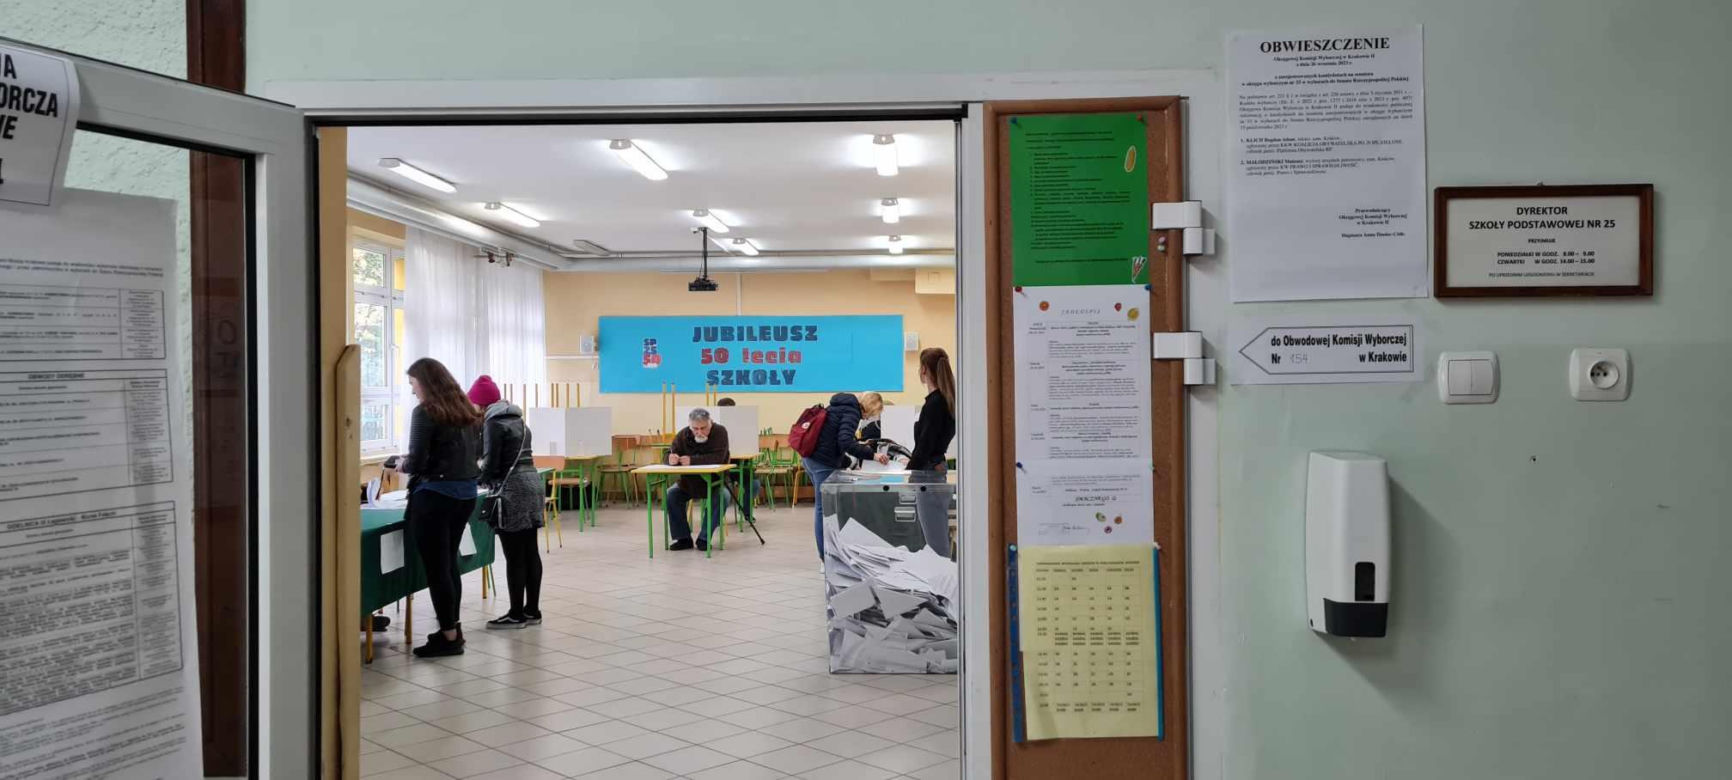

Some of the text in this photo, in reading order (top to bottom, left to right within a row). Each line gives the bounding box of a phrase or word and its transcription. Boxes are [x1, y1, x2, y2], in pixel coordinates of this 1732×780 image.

[1260, 38, 1390, 52] OBWIESZCZENIE
[0, 53, 17, 80] A
[1516, 206, 1568, 215] DYREKTOR
[1469, 219, 1616, 229] SZKOŁY PODSTAWOWEJ NR 25
[692, 326, 818, 342] JUBILEUSZ
[1271, 333, 1407, 348] do Obwodowej Komisji Wyborczej
[701, 347, 802, 364] 50 lecia
[1272, 352, 1407, 364] Nr 154 w Krakowie
[706, 370, 796, 386] SZKOŁY
